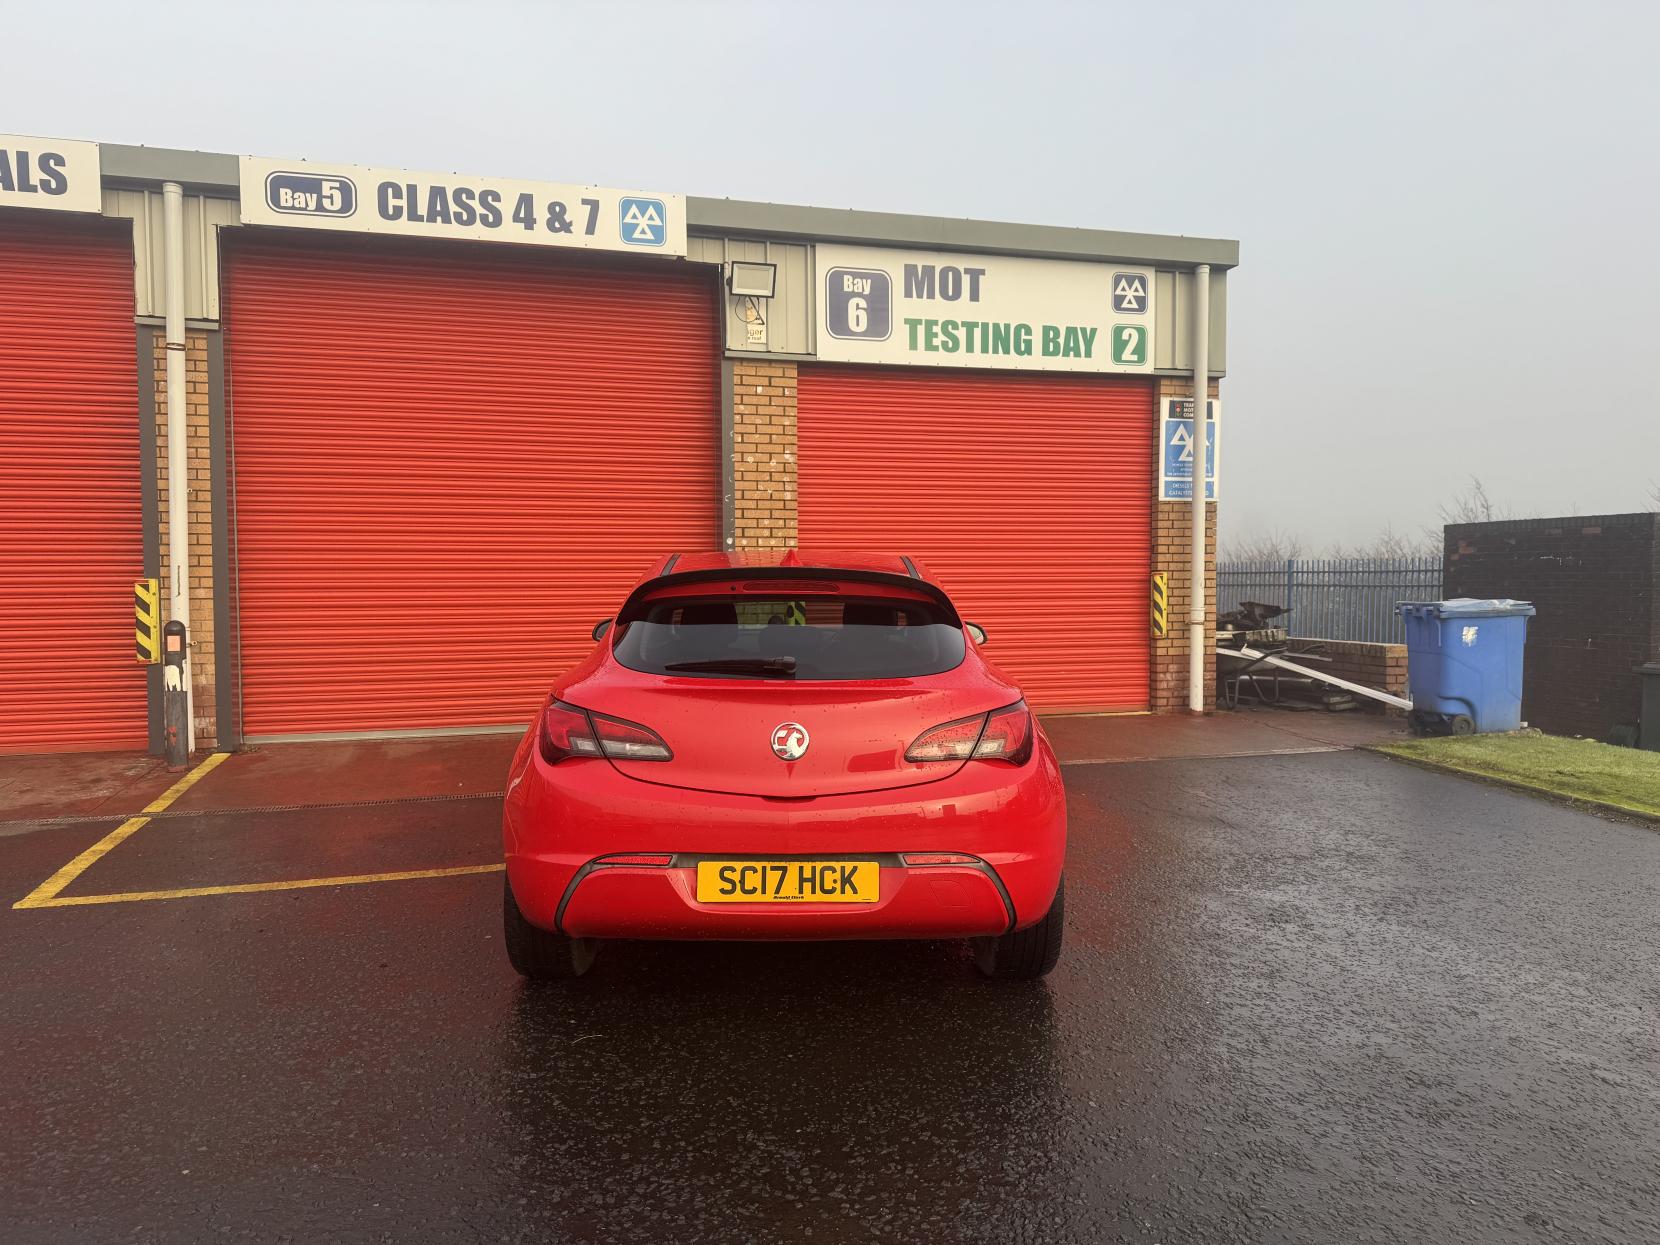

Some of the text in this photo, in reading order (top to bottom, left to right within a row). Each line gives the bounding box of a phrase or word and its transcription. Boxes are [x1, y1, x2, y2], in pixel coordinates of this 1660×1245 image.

[279, 181, 342, 212] Bay 5
[377, 181, 600, 236] CLASS 4 & 7
[843, 274, 871, 295] Bay
[903, 263, 986, 303] MOT
[847, 297, 868, 333] 6
[903, 317, 1098, 358] TESTING BAY
[1120, 327, 1138, 361] 2
[719, 865, 859, 895] SC17 HCK
